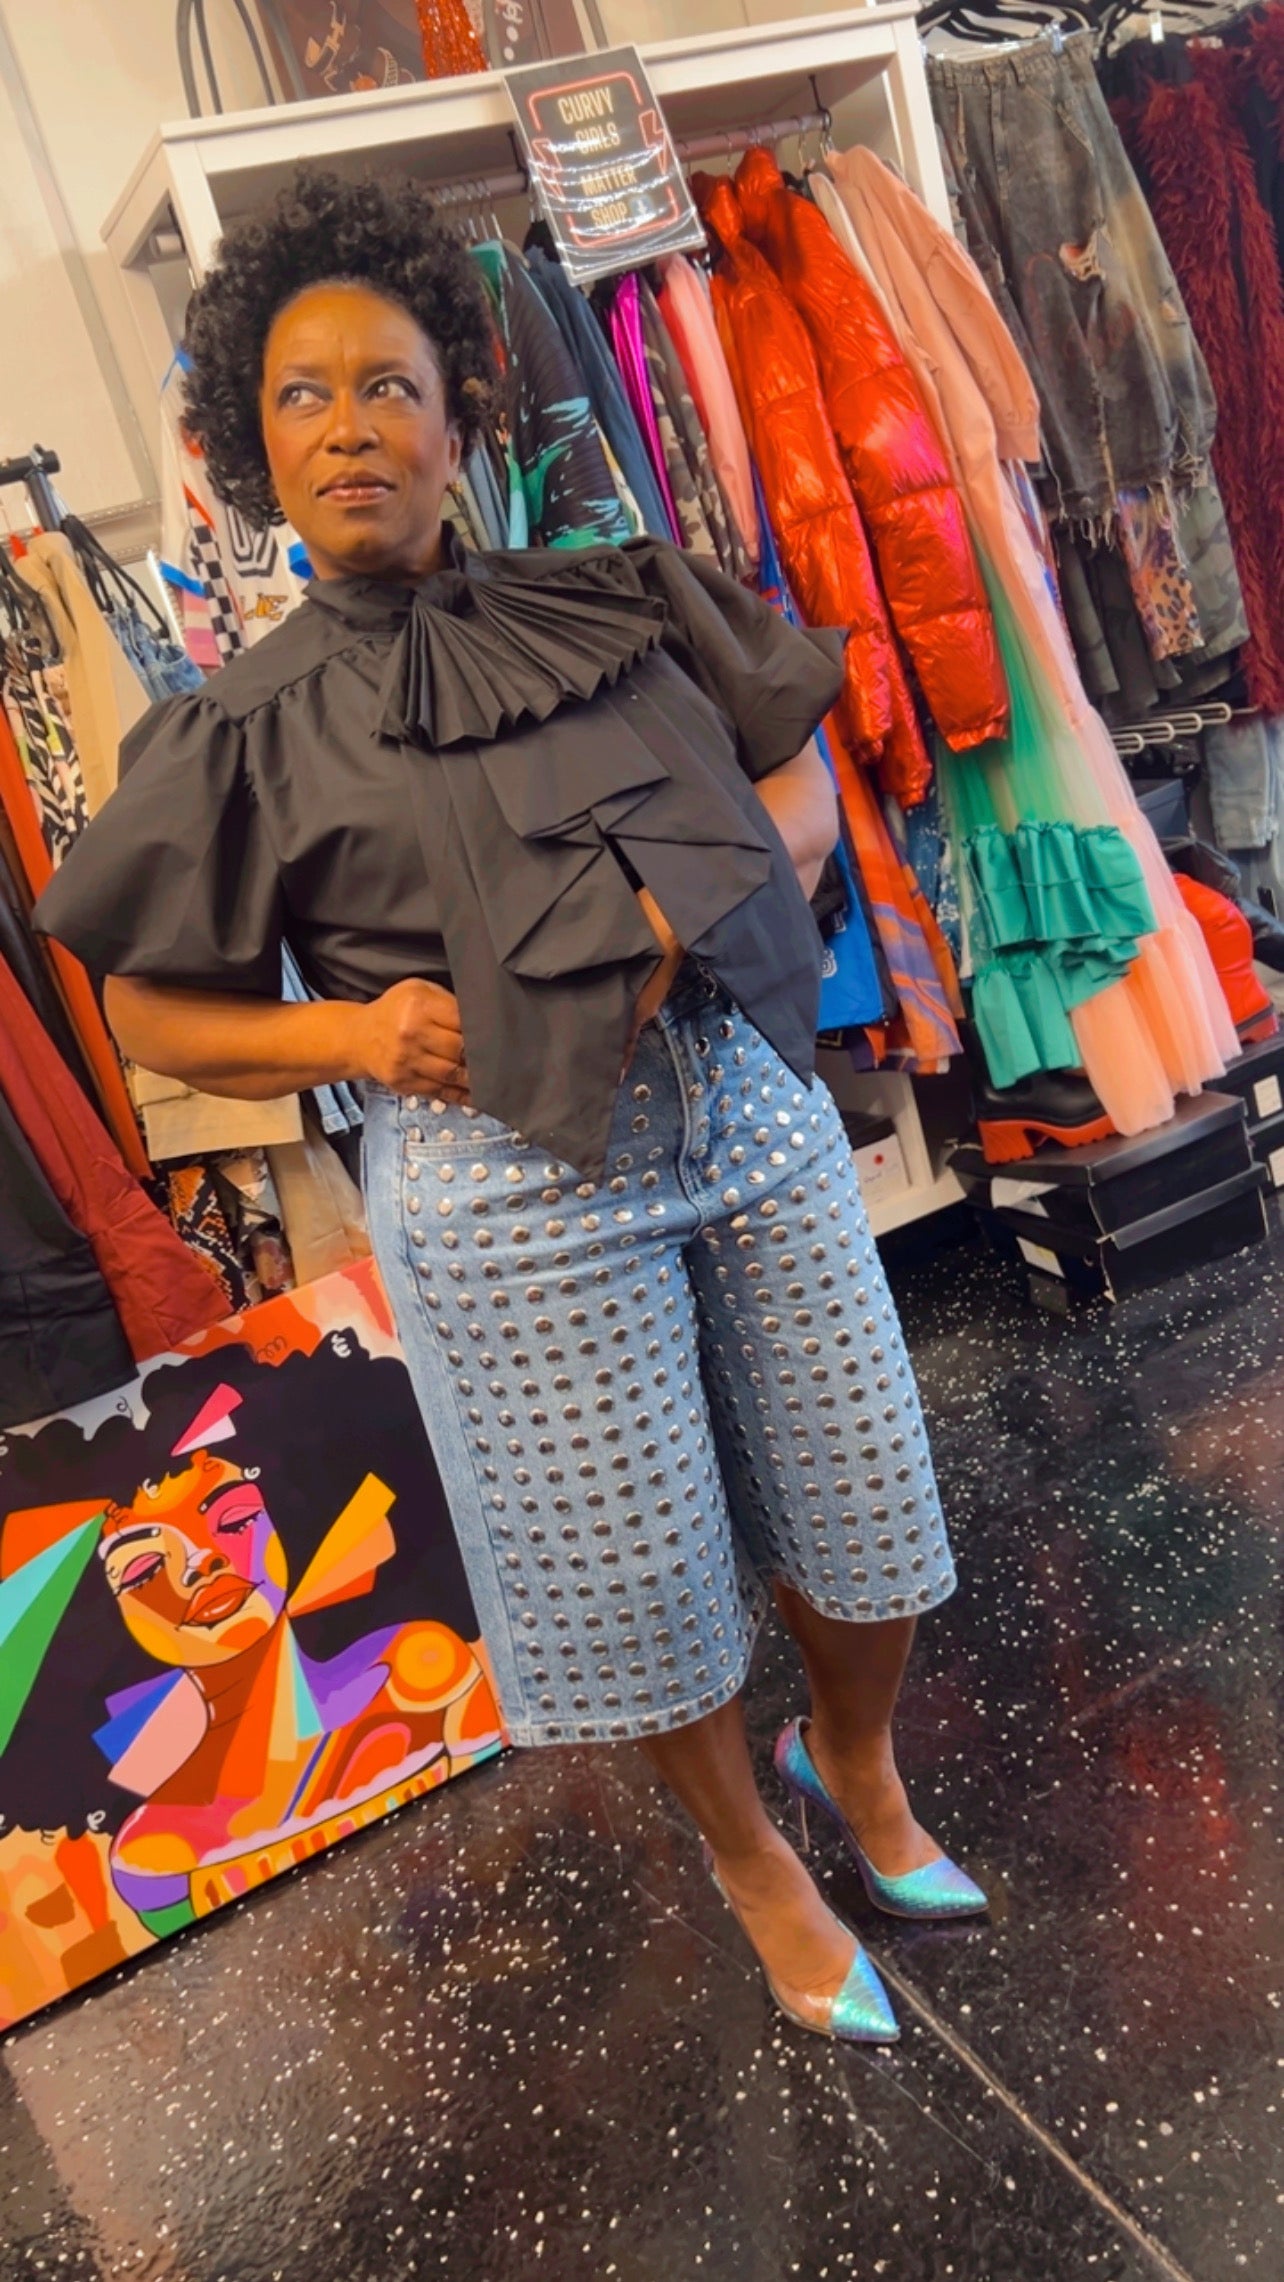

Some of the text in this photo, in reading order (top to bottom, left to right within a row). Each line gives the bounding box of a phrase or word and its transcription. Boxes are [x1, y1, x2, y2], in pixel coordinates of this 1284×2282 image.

[558, 87, 614, 125] CURVY
[575, 121, 620, 154] GIRLS
[580, 164, 637, 196] MATTER
[591, 201, 627, 228] SHOP
